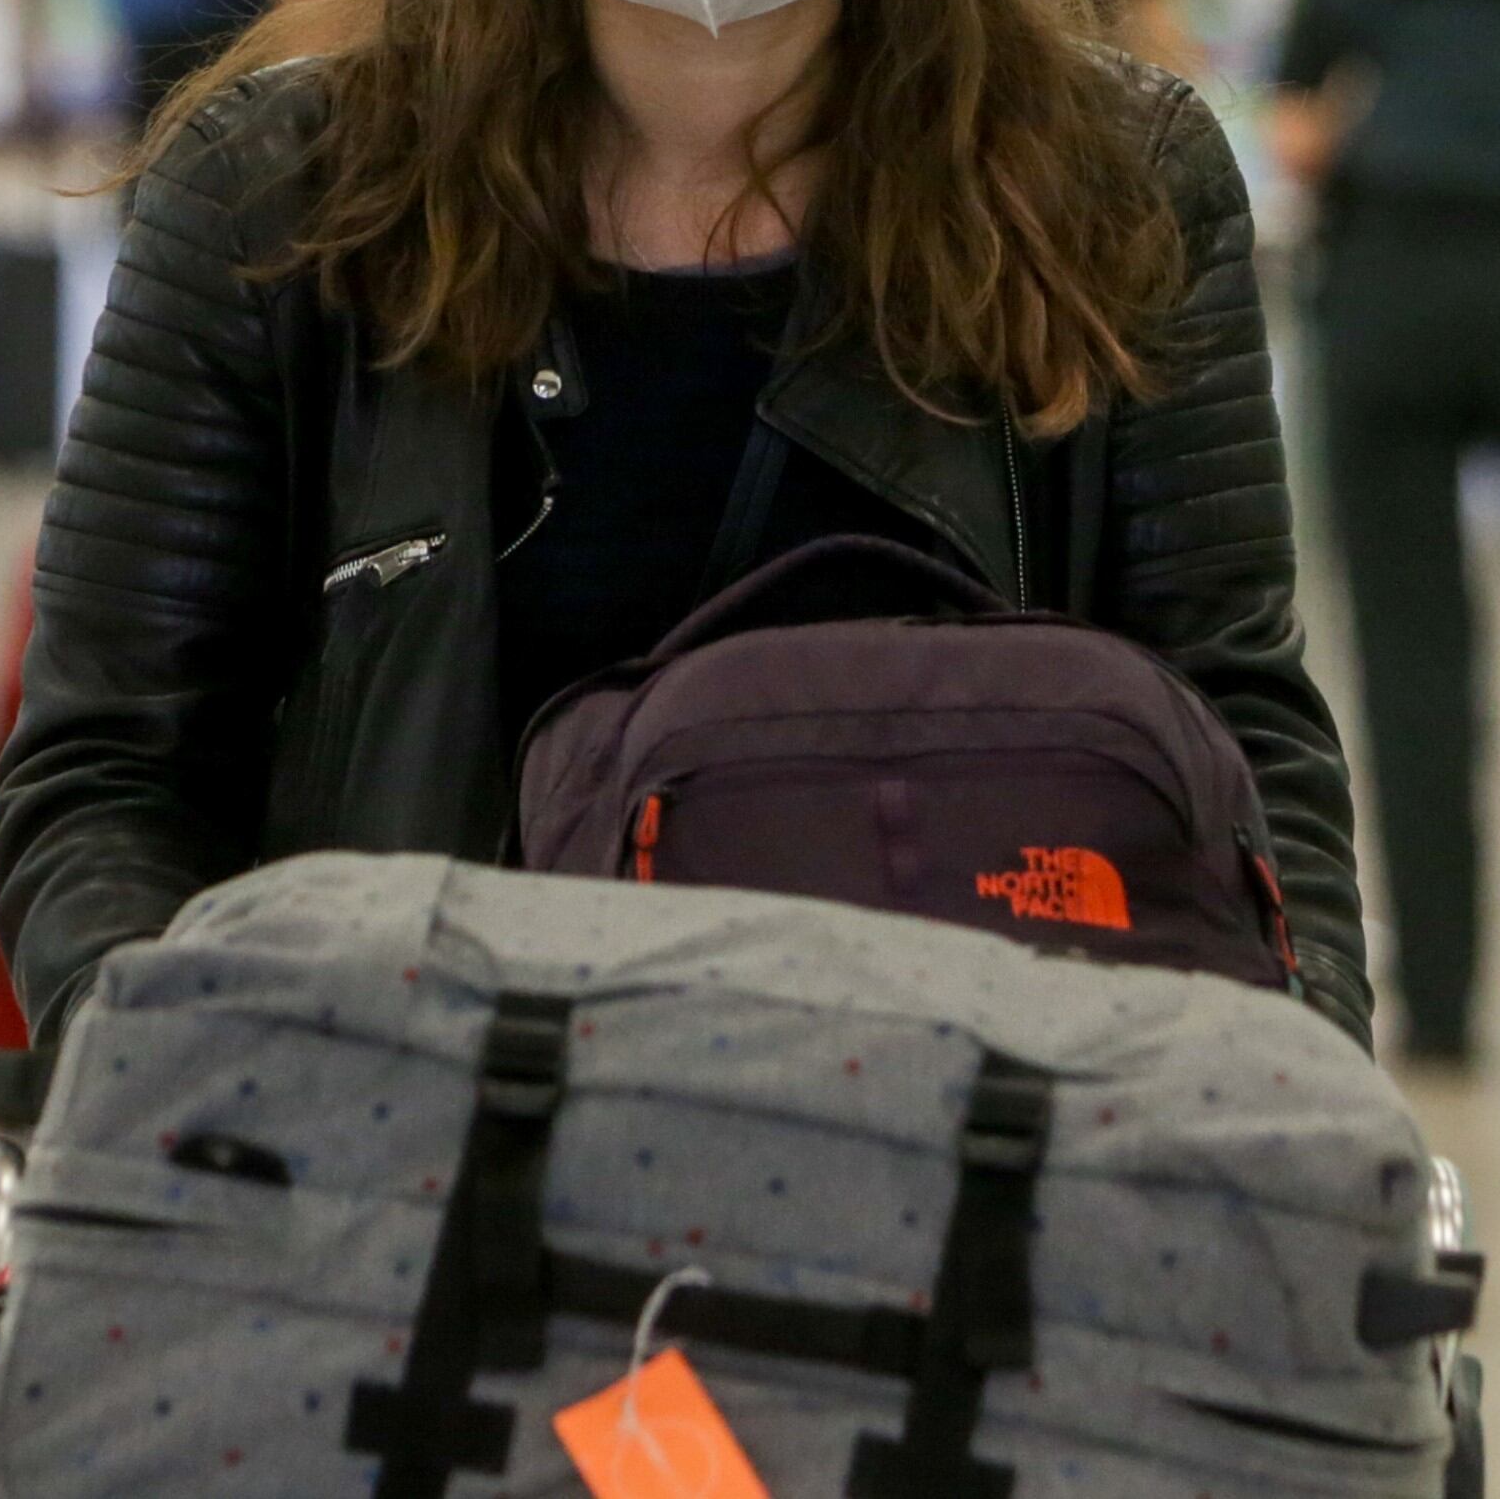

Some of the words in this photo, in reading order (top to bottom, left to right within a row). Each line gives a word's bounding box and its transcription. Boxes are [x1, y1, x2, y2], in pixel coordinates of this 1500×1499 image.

[1020, 846, 1076, 871] THE
[976, 871, 1076, 897] NORTH
[1011, 894, 1076, 921] FACE
